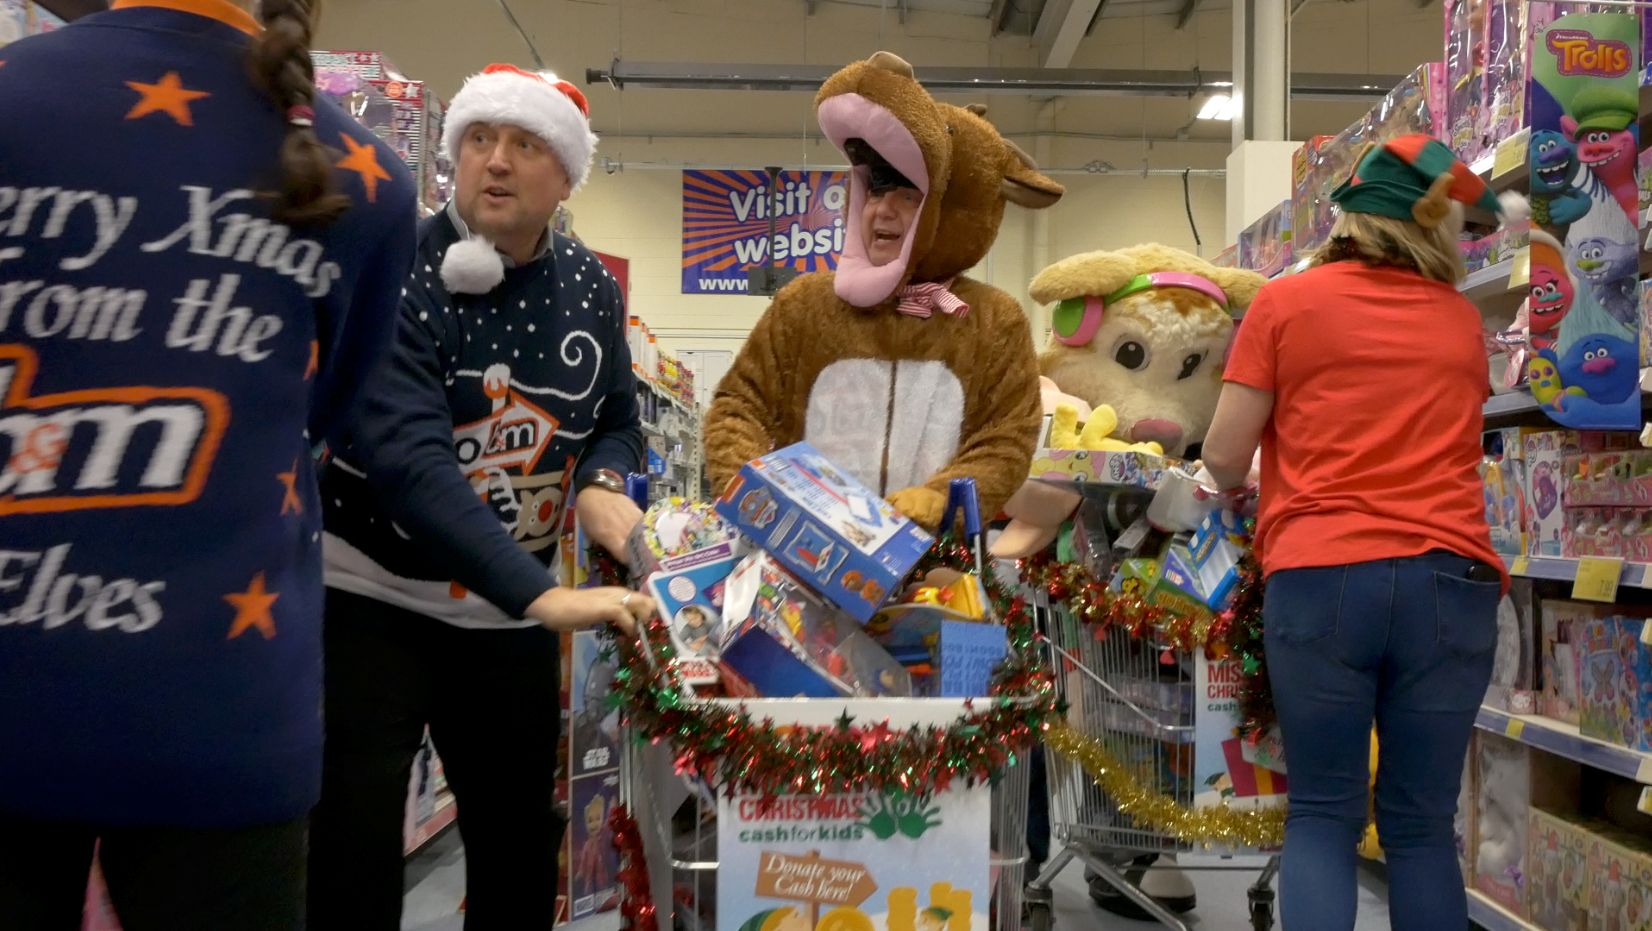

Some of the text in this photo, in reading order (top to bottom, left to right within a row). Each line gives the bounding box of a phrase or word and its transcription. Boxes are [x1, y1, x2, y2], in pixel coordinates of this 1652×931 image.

[729, 181, 811, 222] Visit
[139, 185, 342, 298] Xmas
[734, 218, 847, 264] websi
[165, 273, 284, 363] the
[766, 854, 866, 883] Donate your
[773, 873, 815, 897] Cash
